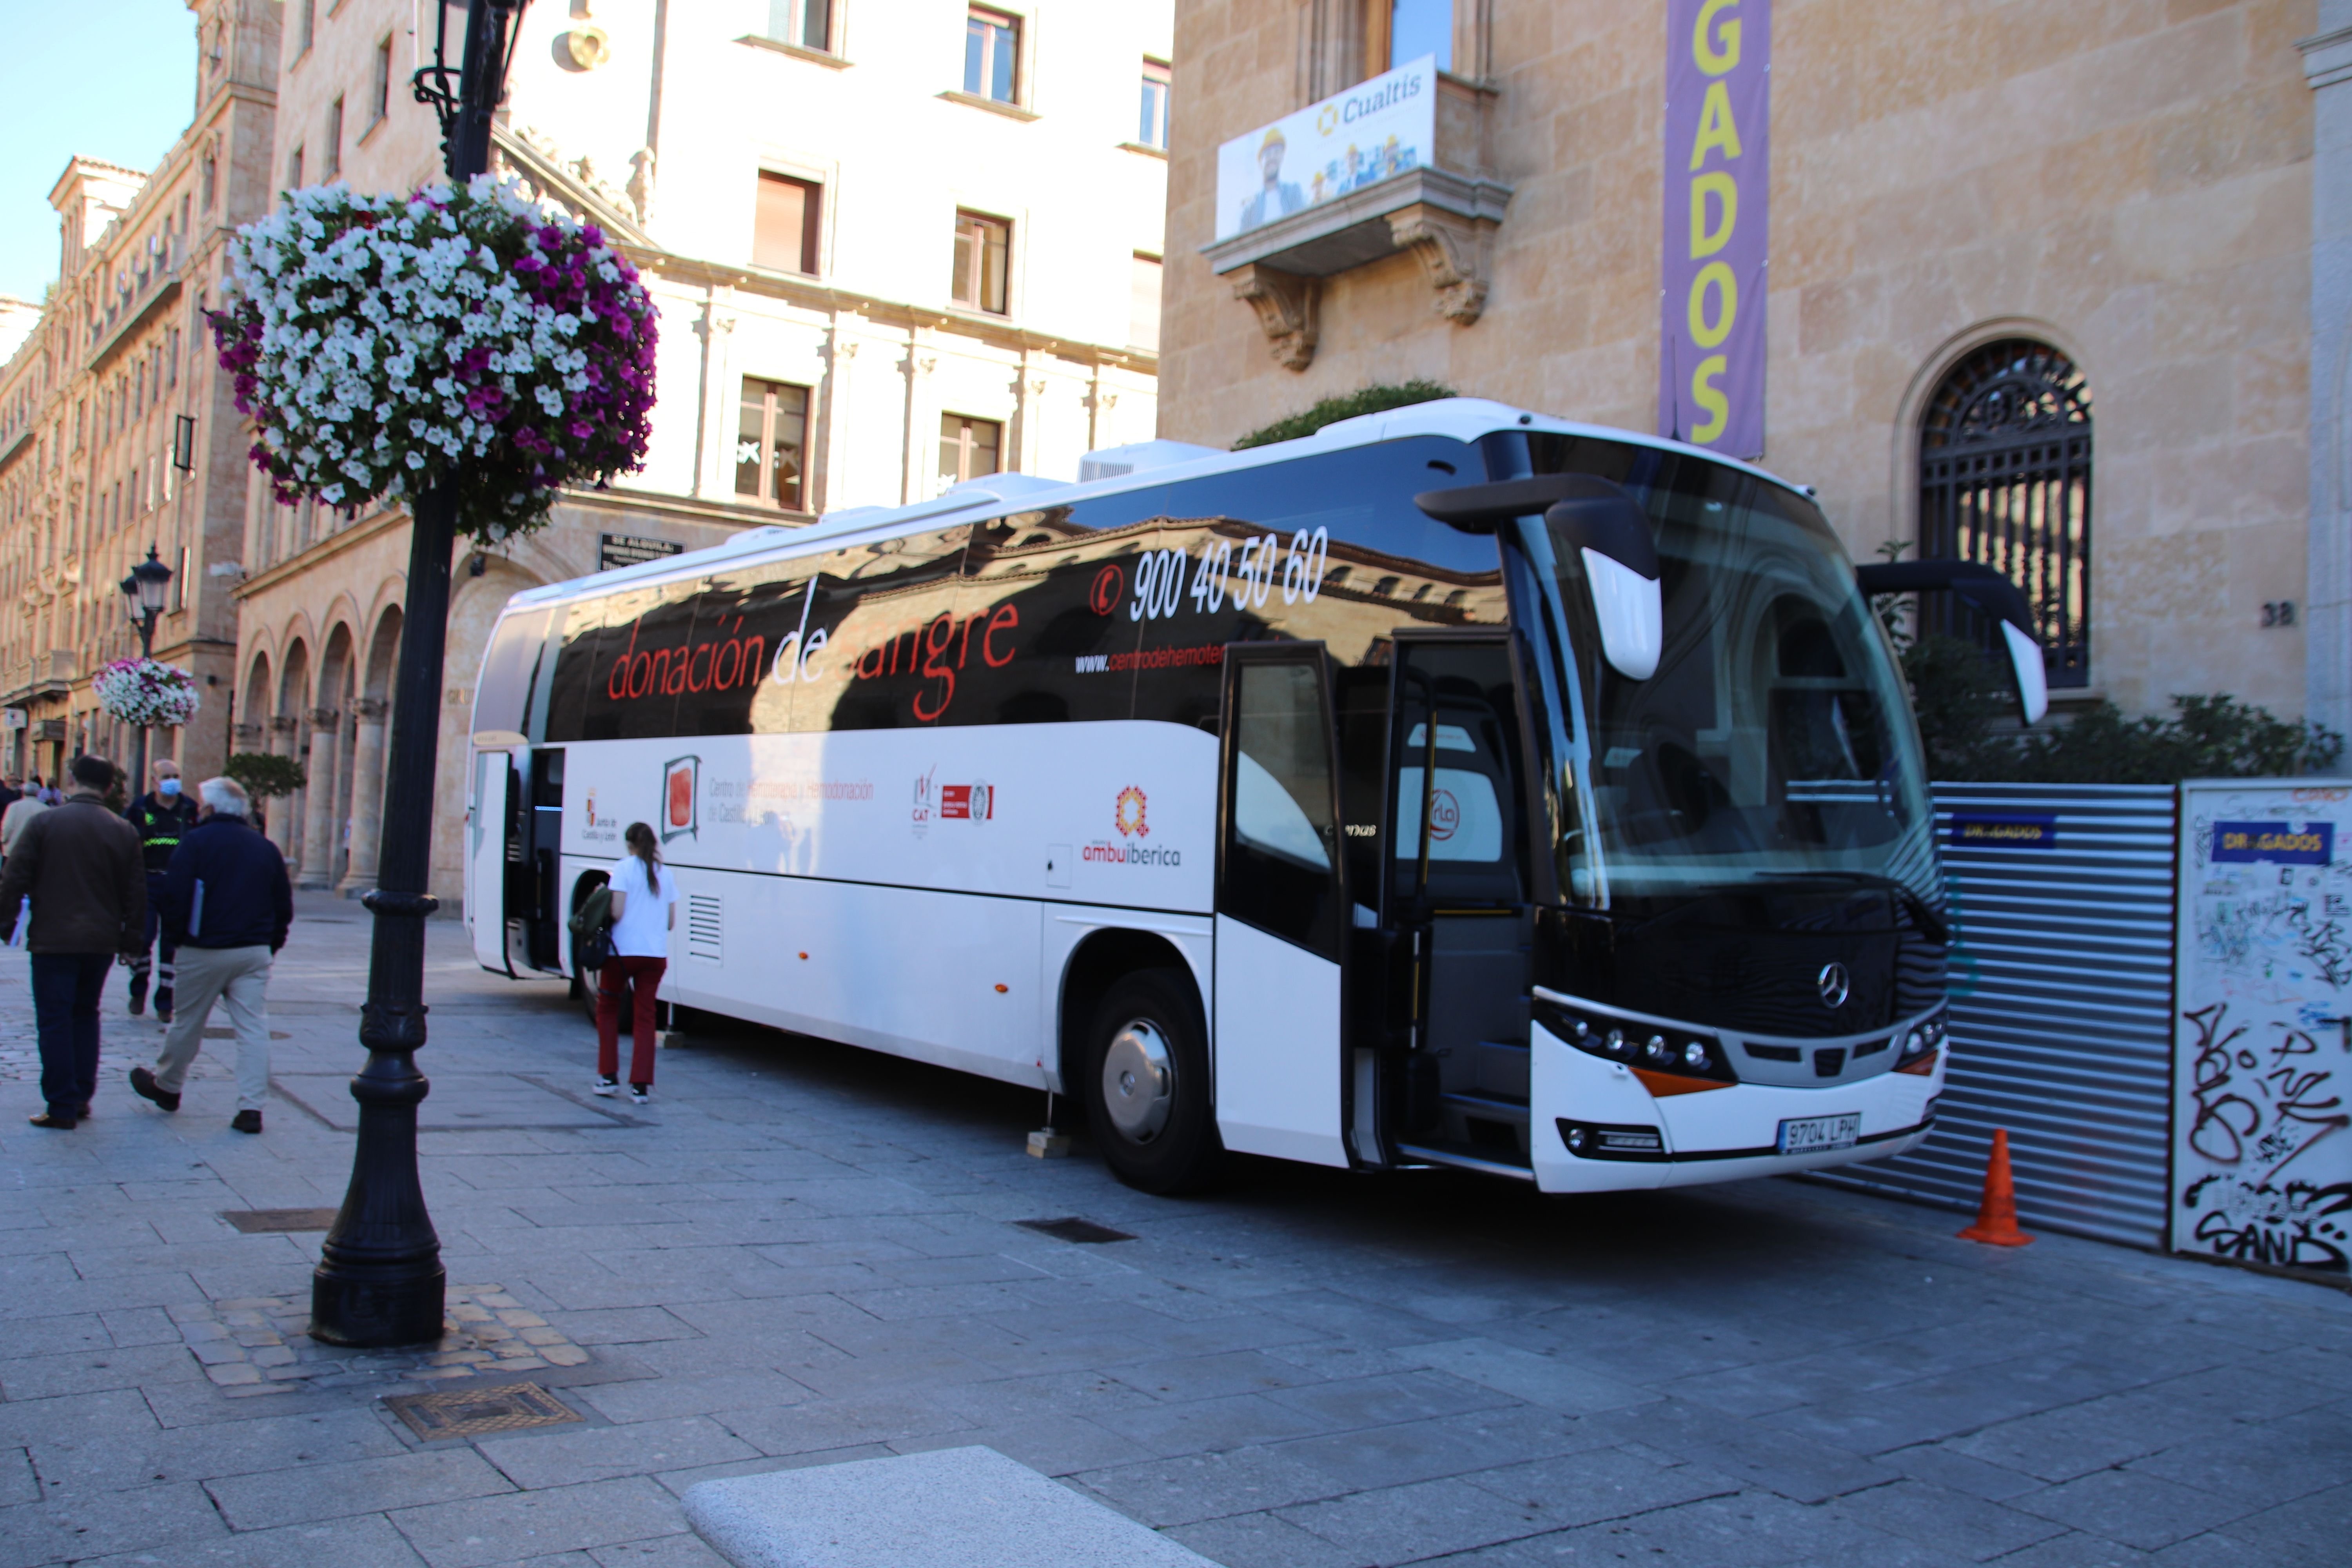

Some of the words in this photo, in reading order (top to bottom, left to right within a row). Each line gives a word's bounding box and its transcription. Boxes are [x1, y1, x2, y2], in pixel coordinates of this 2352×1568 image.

[1344, 73, 1422, 123] Cualtis
[1688, 0, 1742, 443] GADOS
[612, 535, 626, 546] SE
[1130, 546, 1187, 622] 900
[1190, 539, 1231, 614] 40
[1233, 533, 1277, 611] 50
[1283, 526, 1328, 606] 60
[2261, 599, 2296, 627] 38
[609, 614, 765, 700] donación
[772, 574, 828, 686] de
[835, 603, 1019, 722] sangre
[1075, 643, 1225, 674] www.centrodehemoter
[710, 777, 734, 797] Centro
[806, 778, 874, 800] Hemodonación
[913, 809, 929, 822] CAT
[1083, 841, 1181, 866] ambuiberica
[1789, 1122, 1826, 1145] 9704
[1830, 1118, 1858, 1141] LPH
